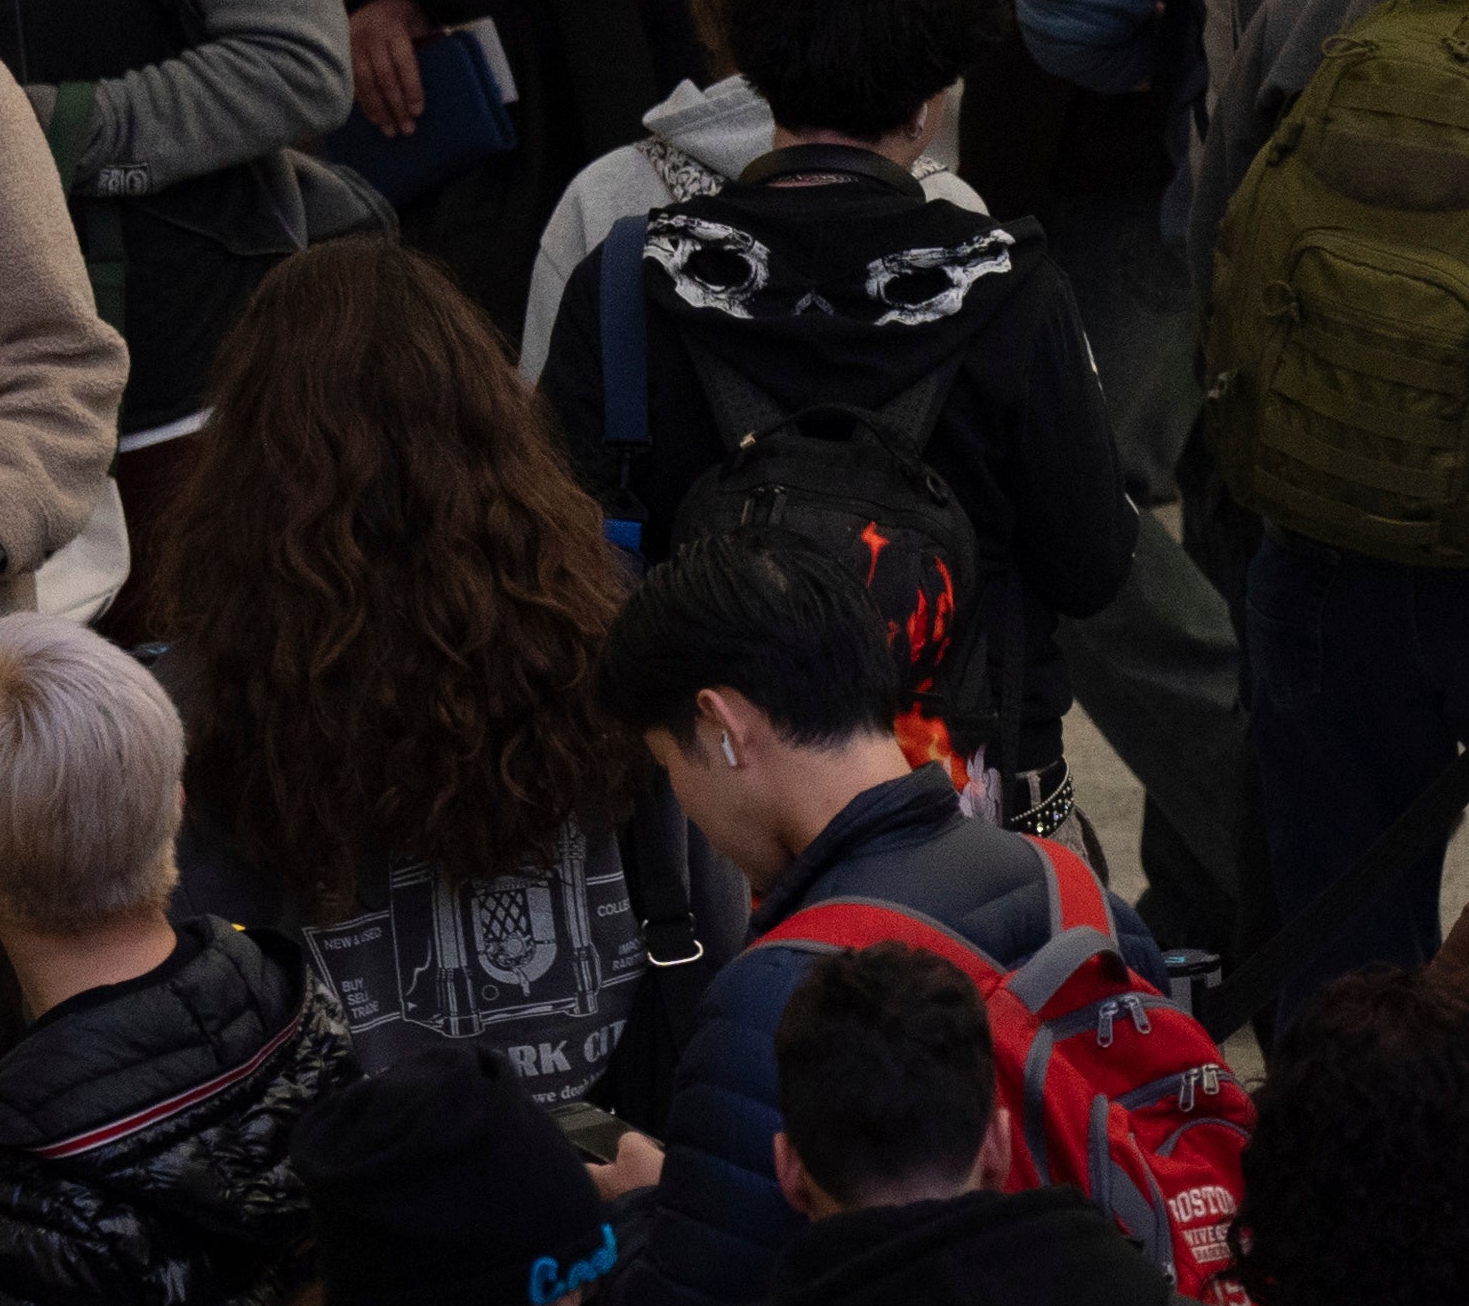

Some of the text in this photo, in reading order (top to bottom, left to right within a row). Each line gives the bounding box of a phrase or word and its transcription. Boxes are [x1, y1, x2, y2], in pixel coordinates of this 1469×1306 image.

[323, 935, 353, 951] NEW
[341, 977, 365, 994] BUY
[346, 991, 371, 1007] SELL
